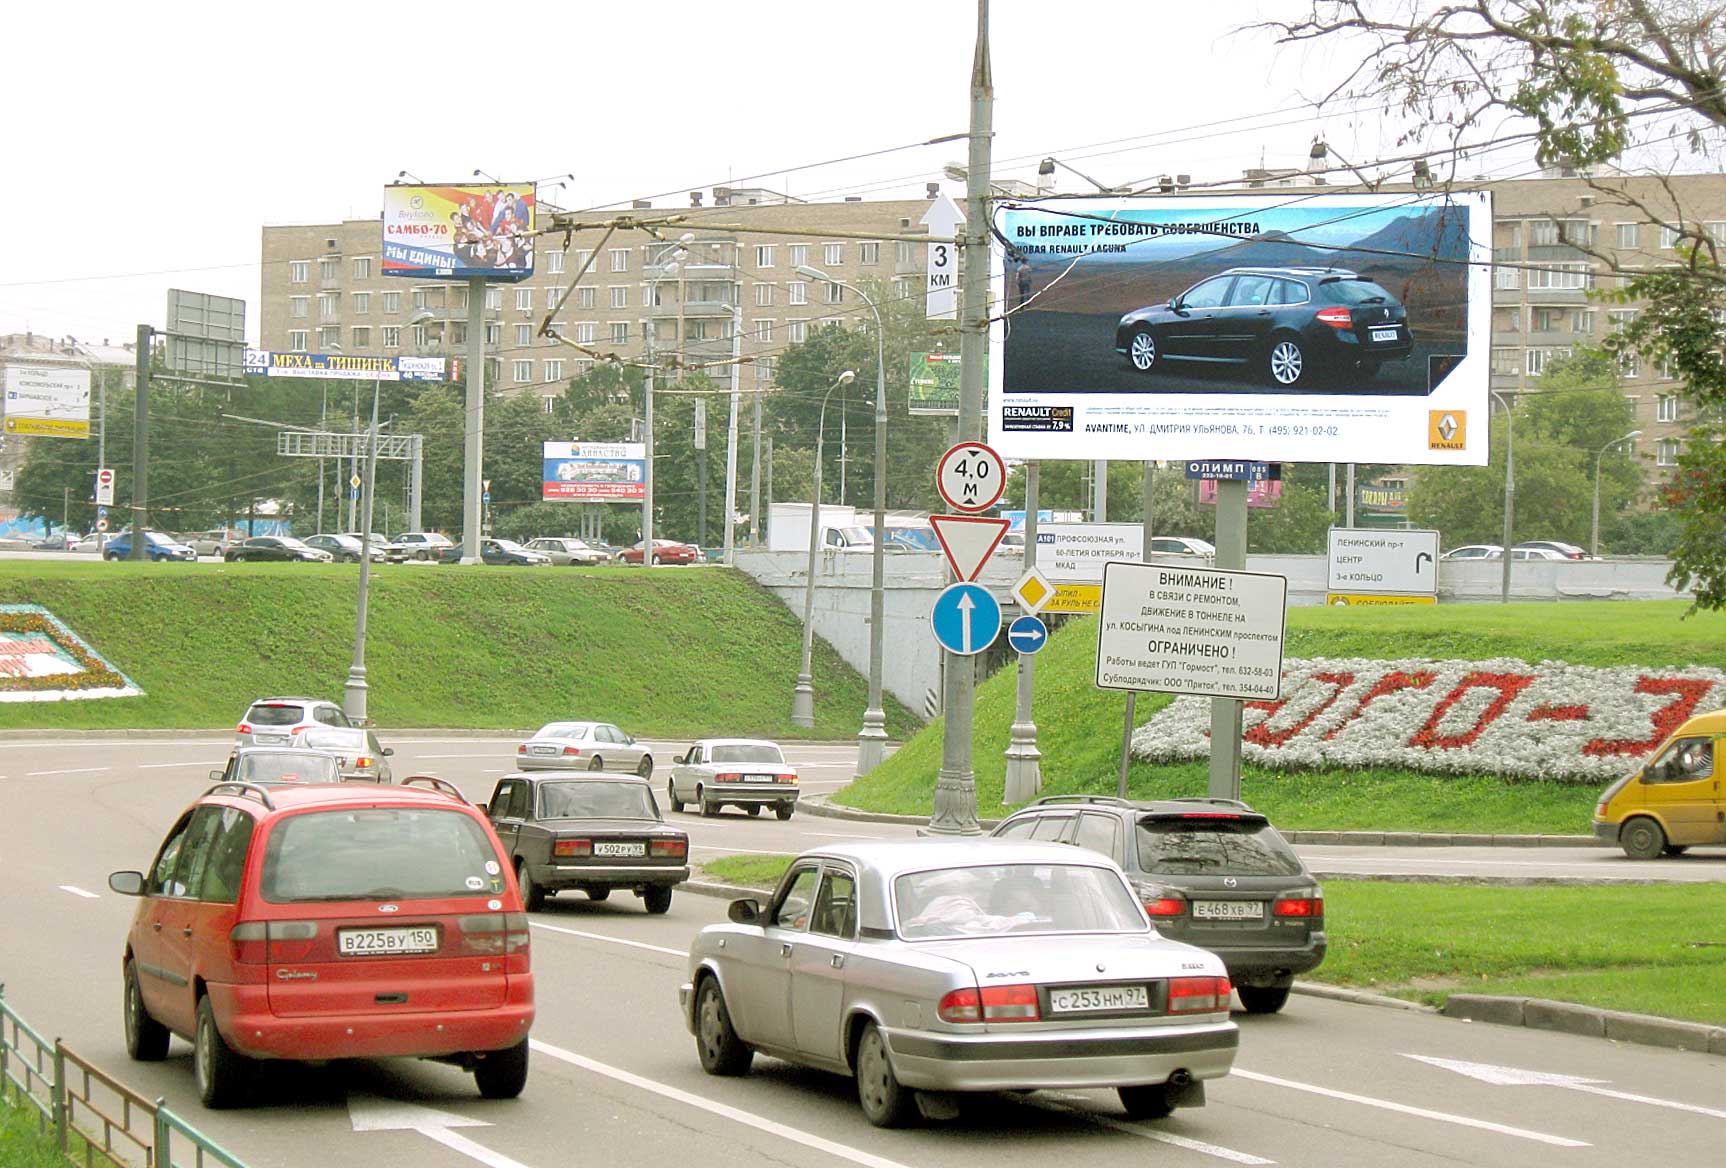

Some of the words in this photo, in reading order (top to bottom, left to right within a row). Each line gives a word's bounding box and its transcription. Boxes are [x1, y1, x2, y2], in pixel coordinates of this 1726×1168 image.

[387, 223, 448, 235] САМБО-70
[1017, 225, 1035, 237] ВЫ
[1040, 224, 1086, 237] ВПРАВЕ
[1090, 223, 1157, 236] ТРЕБОВАТЬ
[1162, 222, 1260, 235] СОВЕРШЕНСТВА
[1091, 244, 1127, 253] LAGUNA
[386, 245, 407, 260] МЫ
[409, 250, 457, 269] ЕДИНЫ!
[934, 245, 947, 267] 3
[930, 274, 950, 286] КМ
[248, 353, 266, 365] 24
[273, 354, 313, 369] МЕХА
[1003, 407, 1051, 417] RENAULT
[1085, 423, 1132, 434] AVANTIME,
[1149, 424, 1191, 435] ДМИТРИЯ
[954, 459, 989, 479] 4,0
[1189, 463, 1244, 472] ОЛИМП
[963, 483, 977, 496] М
[1056, 535, 1114, 544] ПРОФСОЮЗНАЯ
[1337, 539, 1386, 548] ЛЕНИНСКИЙ
[1387, 541, 1404, 549] пр-т
[1091, 550, 1124, 558] ОКТЯБРЯ
[1125, 551, 1141, 559] пр-т
[1336, 556, 1363, 564] ЦЕНТР
[1055, 562, 1076, 570] МКАД
[1159, 573, 1226, 590] ВНИМАНИЕ
[1349, 573, 1383, 582] КОЛЬЦО
[1062, 599, 1081, 607] РУЛЬ
[1149, 590, 1155, 599] В
[1157, 591, 1184, 601] СВЯЗИ
[1185, 593, 1192, 602] С
[1193, 594, 1241, 607] РЕМОНТОМ,
[1141, 606, 1186, 618] ДВИЖЕНИЕ
[1187, 610, 1194, 618] В
[1196, 610, 1233, 622] ТОННЕЛЕ
[1234, 614, 1246, 623] НА
[1105, 622, 1118, 631] ул.
[1119, 621, 1165, 633] КОСЫГИНА
[1166, 626, 1181, 635] под
[1182, 626, 1232, 638] ЛЕНИНСКИМ
[1233, 631, 1278, 642] проспектом
[1148, 640, 1229, 659] ОГРАНИЧЕНО
[1106, 655, 1136, 667] Работы
[1137, 660, 1160, 669] ведет
[1161, 660, 1177, 670] ГУП
[1222, 666, 1237, 674] тел.
[1103, 672, 1162, 687] Субподрядчик:
[1163, 677, 1182, 688] ООО
[1222, 683, 1238, 692] тел.
[1239, 682, 1274, 694] 354-04-40
[1126, 988, 1140, 1000] 97
